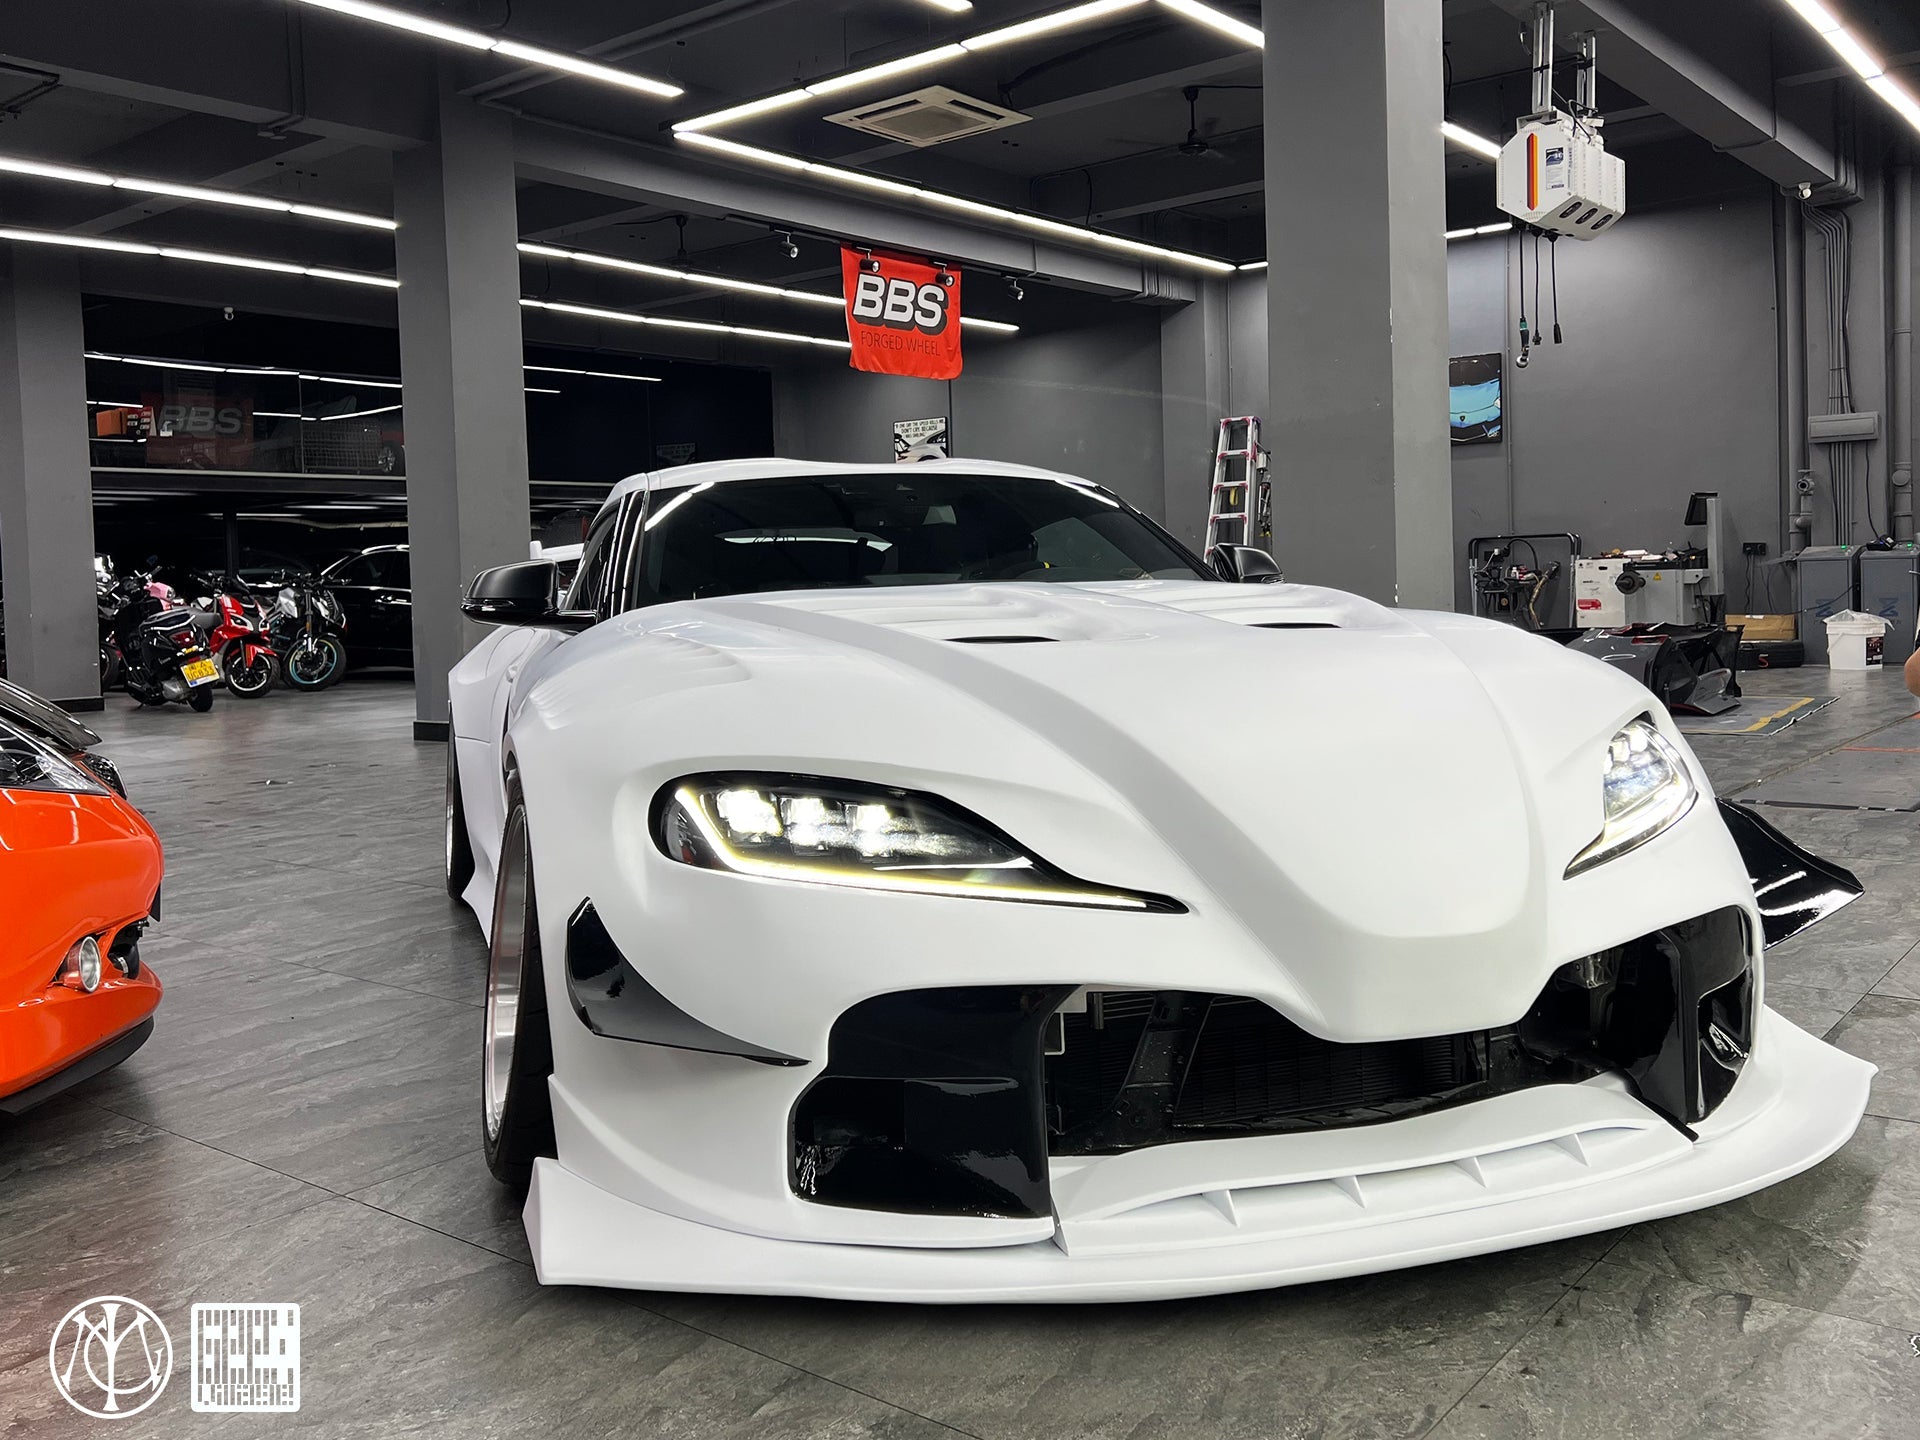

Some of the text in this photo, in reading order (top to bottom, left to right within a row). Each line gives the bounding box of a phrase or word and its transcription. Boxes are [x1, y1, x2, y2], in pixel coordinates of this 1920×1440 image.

[852, 272, 948, 334] BBS
[861, 330, 941, 356] FORGED WHEEL
[157, 405, 242, 433] BBS
